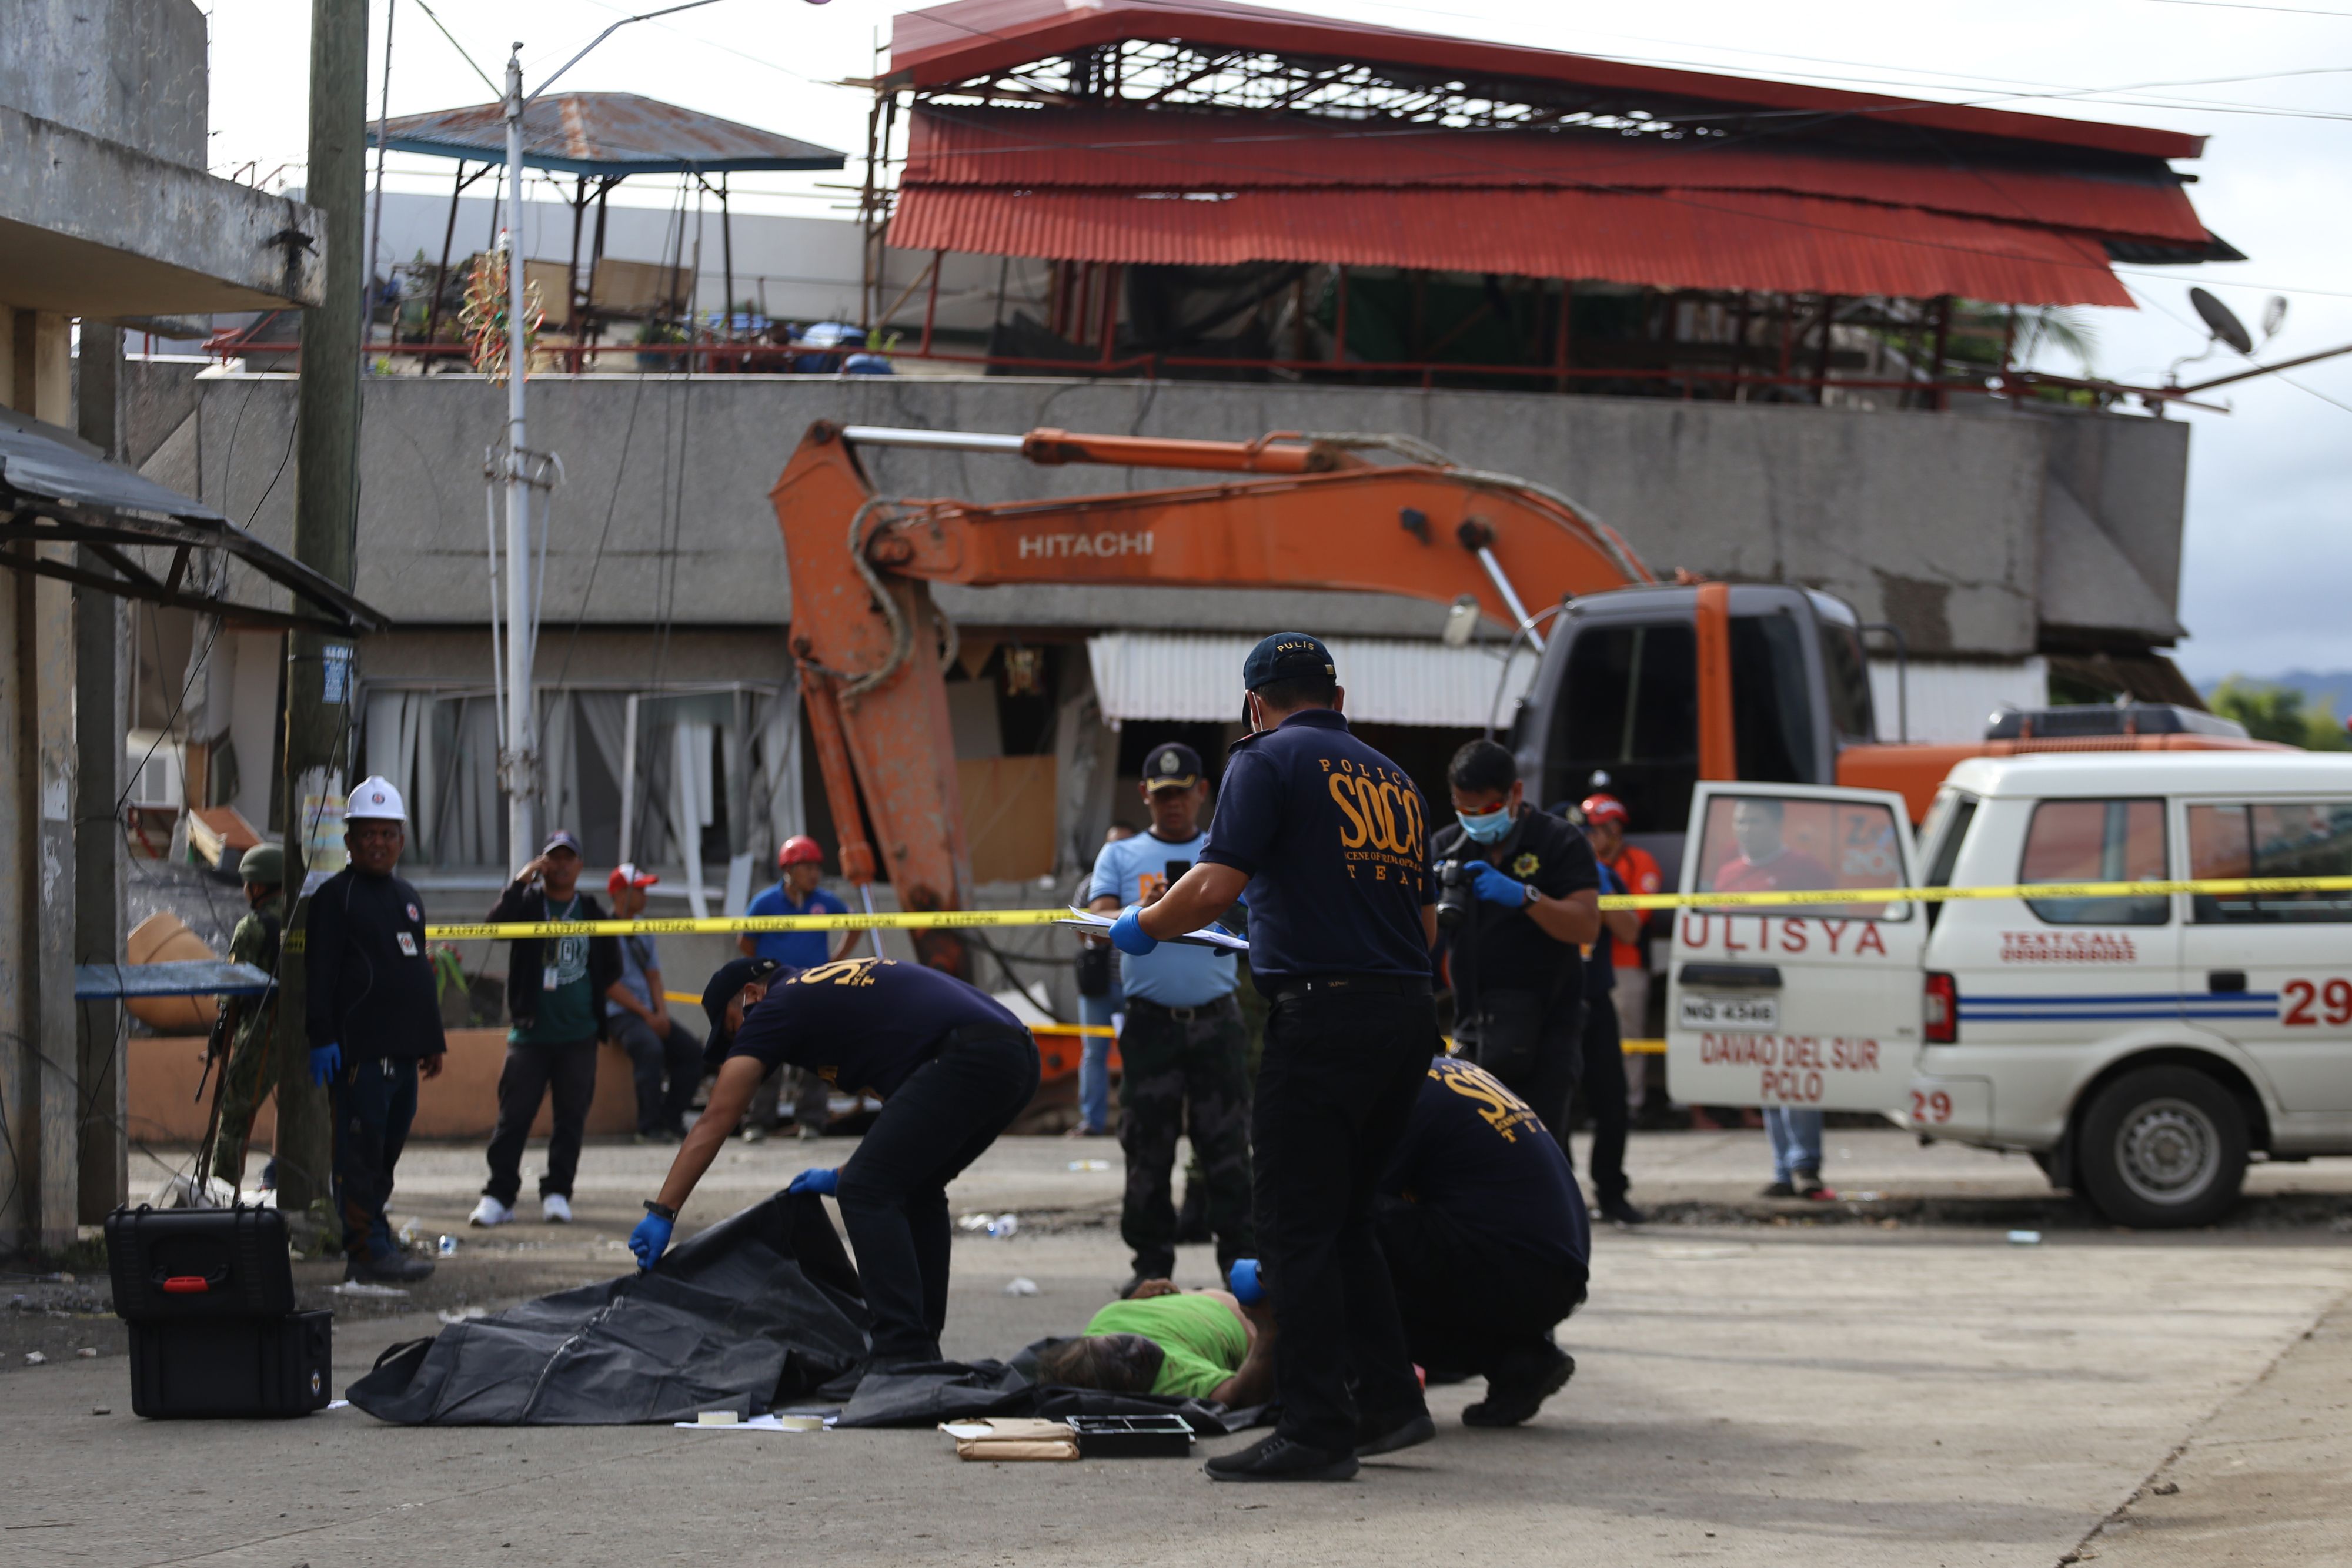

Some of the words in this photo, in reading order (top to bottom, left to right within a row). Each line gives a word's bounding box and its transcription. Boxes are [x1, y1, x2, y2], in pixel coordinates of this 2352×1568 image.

[1018, 531, 1154, 559] HITACHI
[1277, 641, 1314, 653] PULIS
[1329, 773, 1424, 862] SOCO
[1681, 915, 1887, 957] ULISYA
[2282, 978, 2352, 1027] 29
[1700, 1032, 1778, 1066] DAVAO
[1783, 1035, 1825, 1070] DEL
[1832, 1037, 1880, 1072] SUR
[1762, 1070, 1823, 1102] PCLO
[1910, 1089, 1952, 1124] 29
